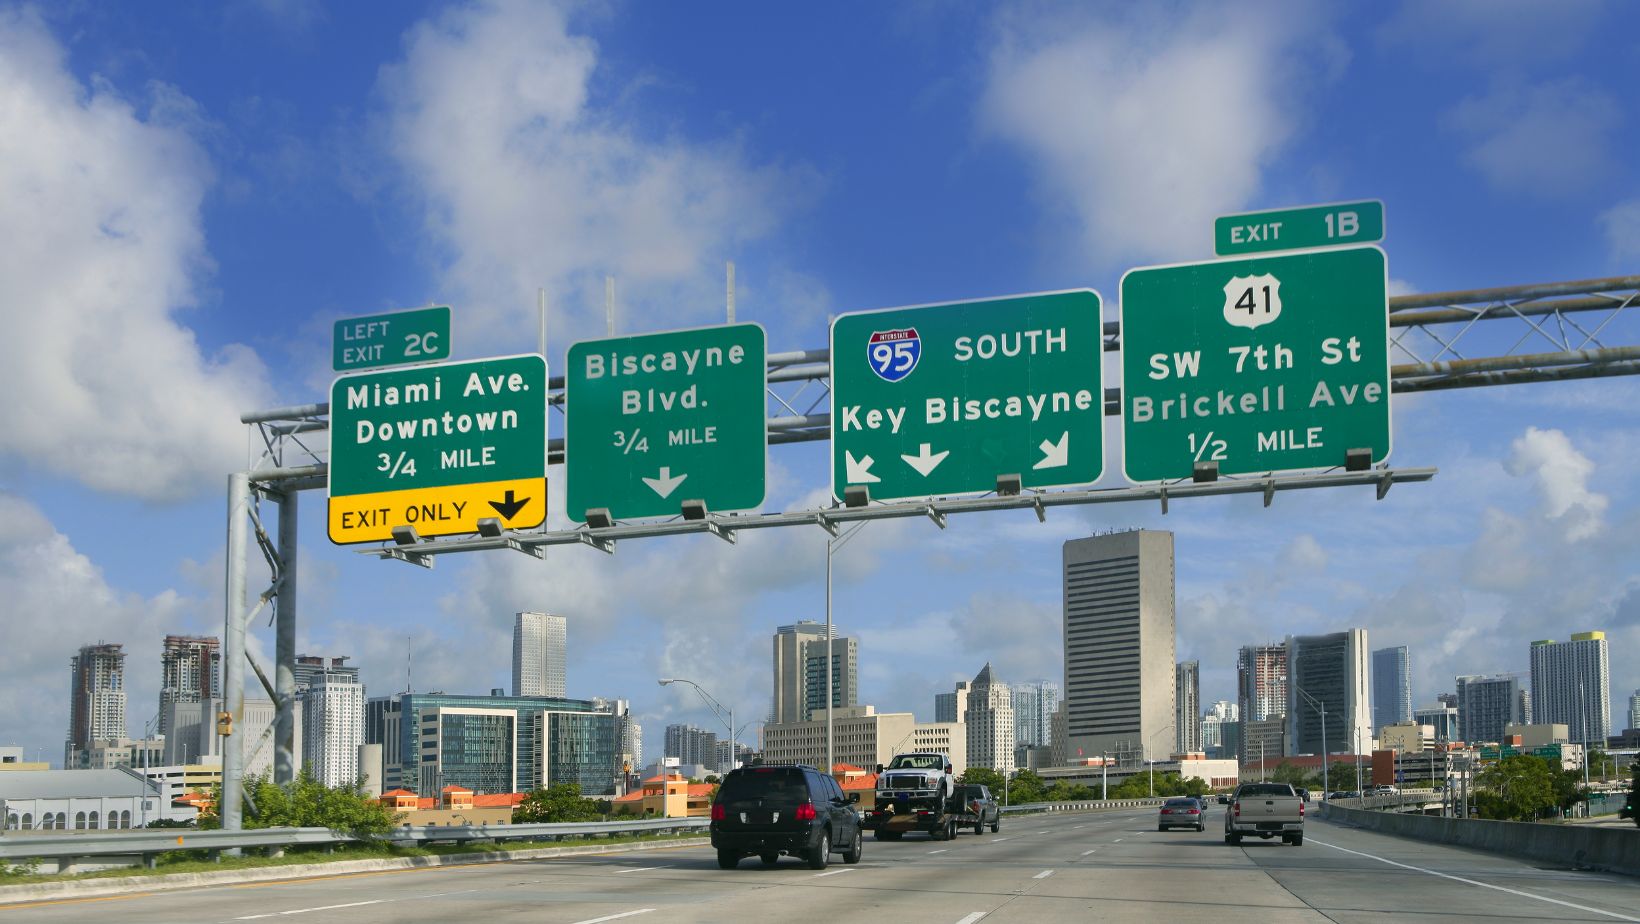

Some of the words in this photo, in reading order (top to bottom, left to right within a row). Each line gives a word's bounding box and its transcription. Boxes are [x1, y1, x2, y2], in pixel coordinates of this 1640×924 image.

[1231, 223, 1283, 243] EXIT
[1324, 212, 1360, 237] 1B
[1234, 286, 1271, 315] 41
[344, 321, 390, 340] LEFT
[880, 332, 909, 341] INTERSTATE
[344, 345, 384, 363] EXIT
[404, 332, 439, 356] 2C
[586, 345, 744, 379] Biscayne
[872, 342, 914, 373] 95
[954, 328, 1067, 361] SOUTH
[1149, 351, 1201, 379] SW
[1229, 344, 1293, 372] 7th
[1321, 336, 1361, 364] St
[348, 377, 441, 409] Miami
[464, 373, 529, 396] Ave.
[622, 384, 707, 415] Blvd.
[1132, 385, 1284, 423] Brickell
[1310, 381, 1382, 407] Ave
[357, 410, 517, 443] Downtown
[842, 406, 906, 433] Key
[926, 390, 1092, 424] Biscayne
[613, 429, 649, 454] 3/4
[669, 427, 717, 446] MILE
[1187, 431, 1228, 462] 1/2
[1258, 427, 1324, 452] MILE
[377, 452, 416, 478] 3/4
[441, 447, 495, 469] MILE
[342, 509, 391, 529] EXIT
[405, 502, 467, 523] ONLY
